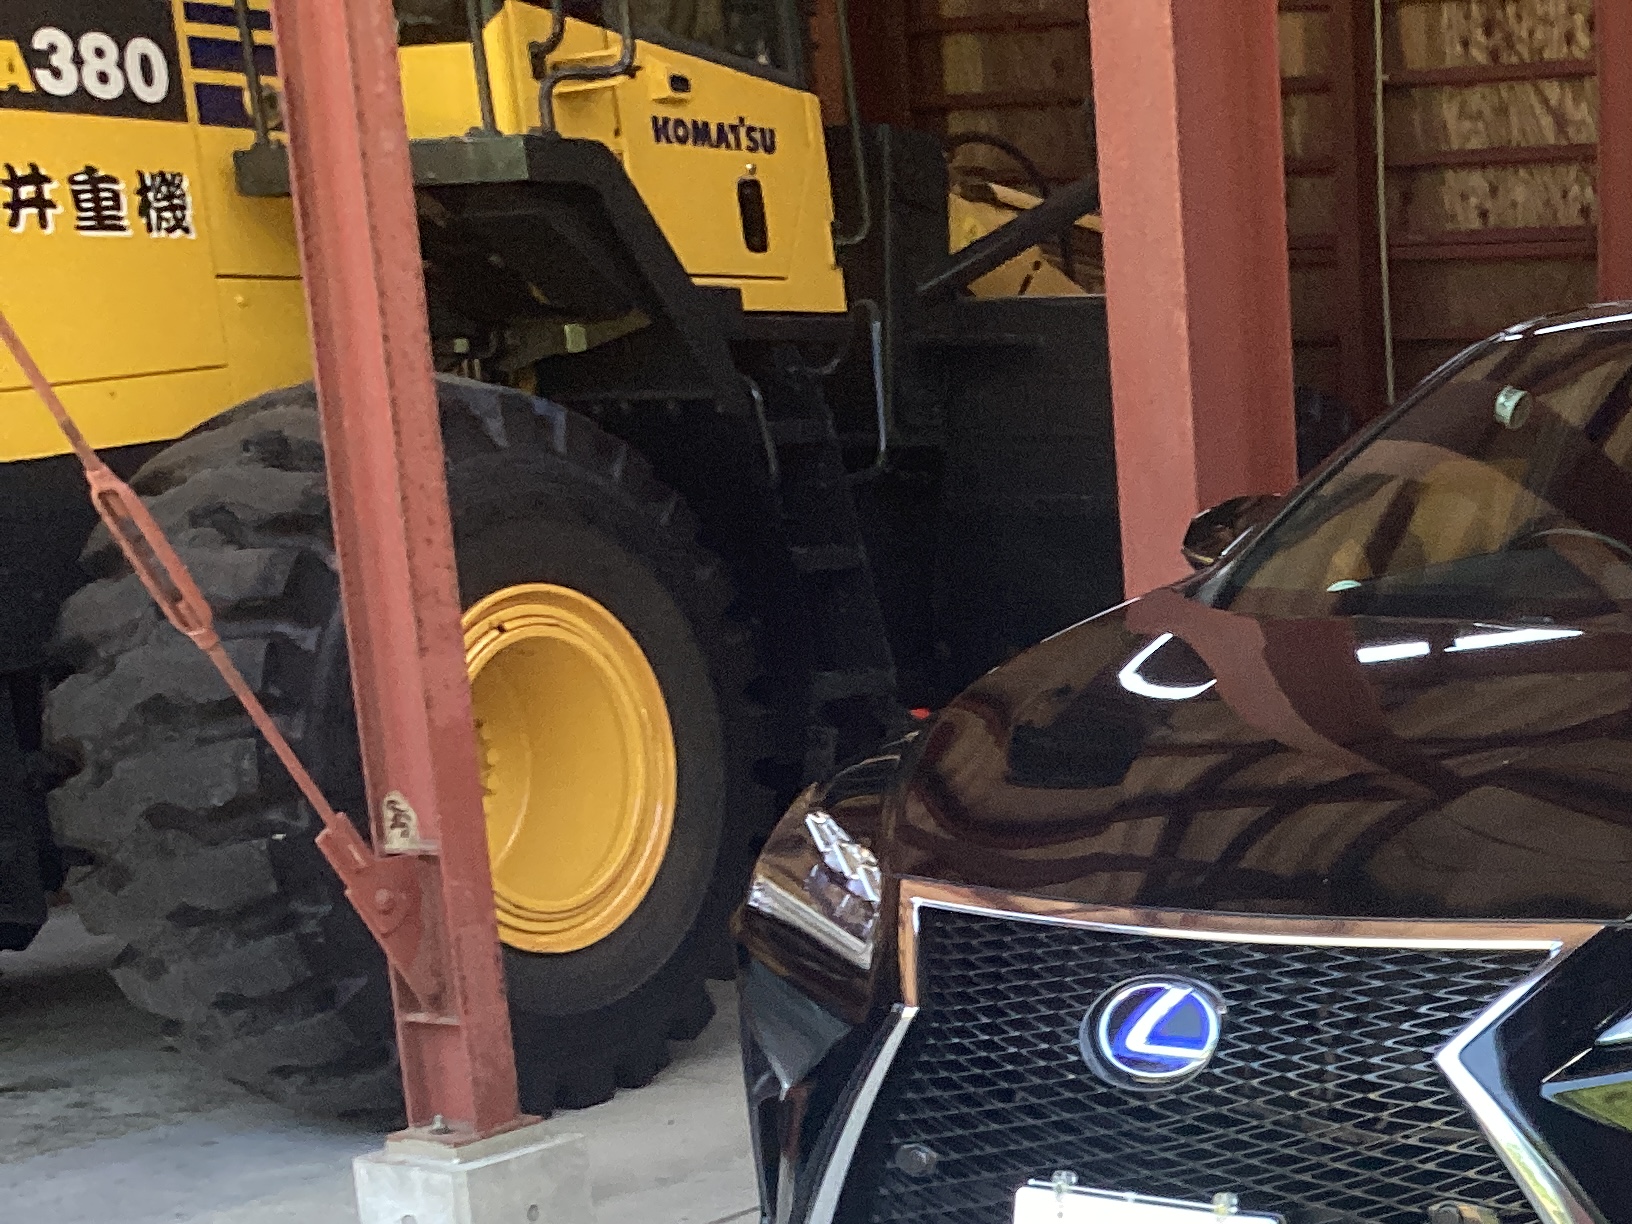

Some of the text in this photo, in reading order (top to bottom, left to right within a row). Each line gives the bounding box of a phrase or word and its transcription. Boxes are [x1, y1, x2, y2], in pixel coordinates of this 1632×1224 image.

[651, 115, 777, 155] KOMATSU
[0, 162, 196, 239] 井重機
